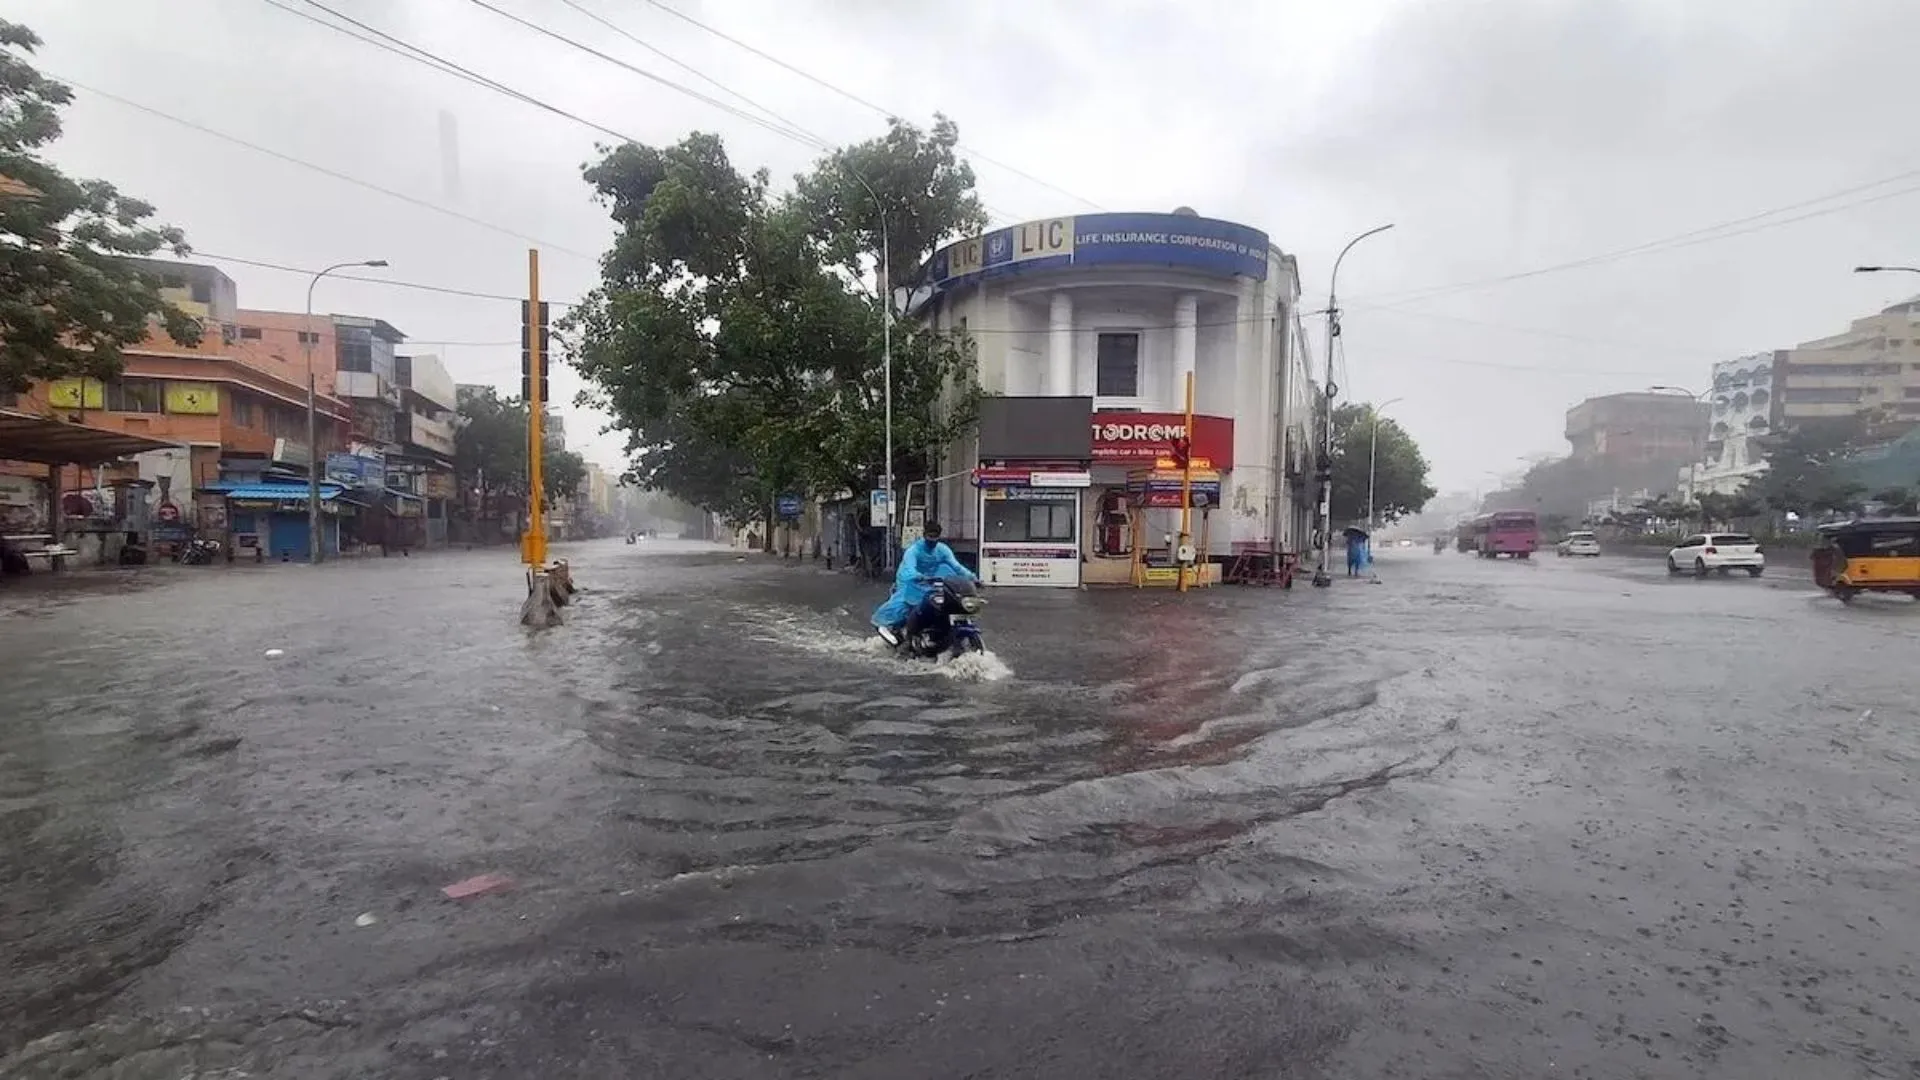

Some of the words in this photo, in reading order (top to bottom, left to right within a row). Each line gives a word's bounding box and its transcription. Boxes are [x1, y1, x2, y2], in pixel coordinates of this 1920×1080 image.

[1021, 220, 1063, 253] LIC
[1076, 233, 1099, 245] LIFE
[1102, 232, 1168, 244] INSURANCE
[1170, 233, 1237, 252] CORPORATION
[953, 243, 978, 268] LIC
